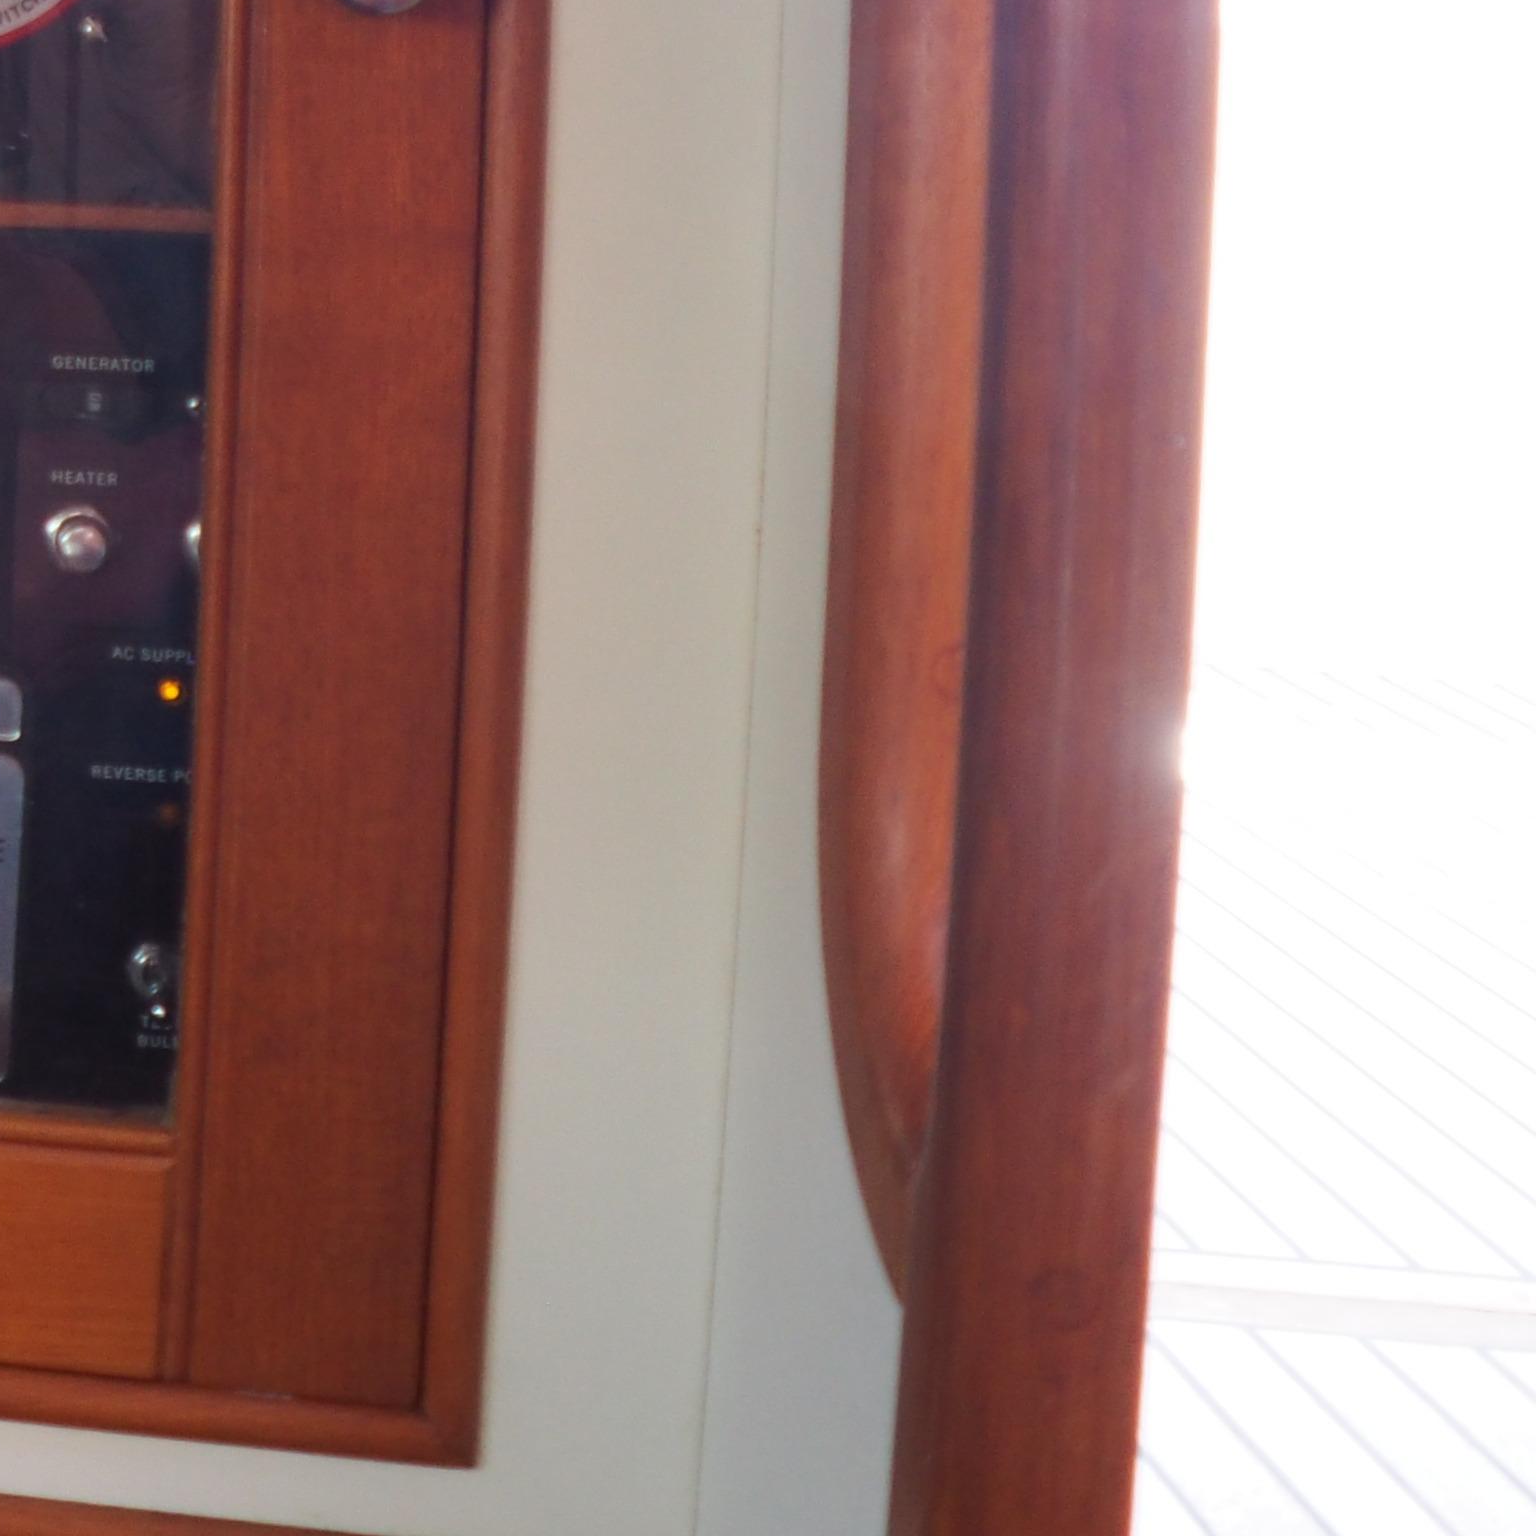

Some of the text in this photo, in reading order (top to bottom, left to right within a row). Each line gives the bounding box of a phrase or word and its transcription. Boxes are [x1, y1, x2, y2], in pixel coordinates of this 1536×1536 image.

[51, 354, 156, 374] GENERATOR
[49, 469, 118, 487] HEATER
[112, 645, 135, 662] AC
[91, 764, 168, 783] REVERSE
